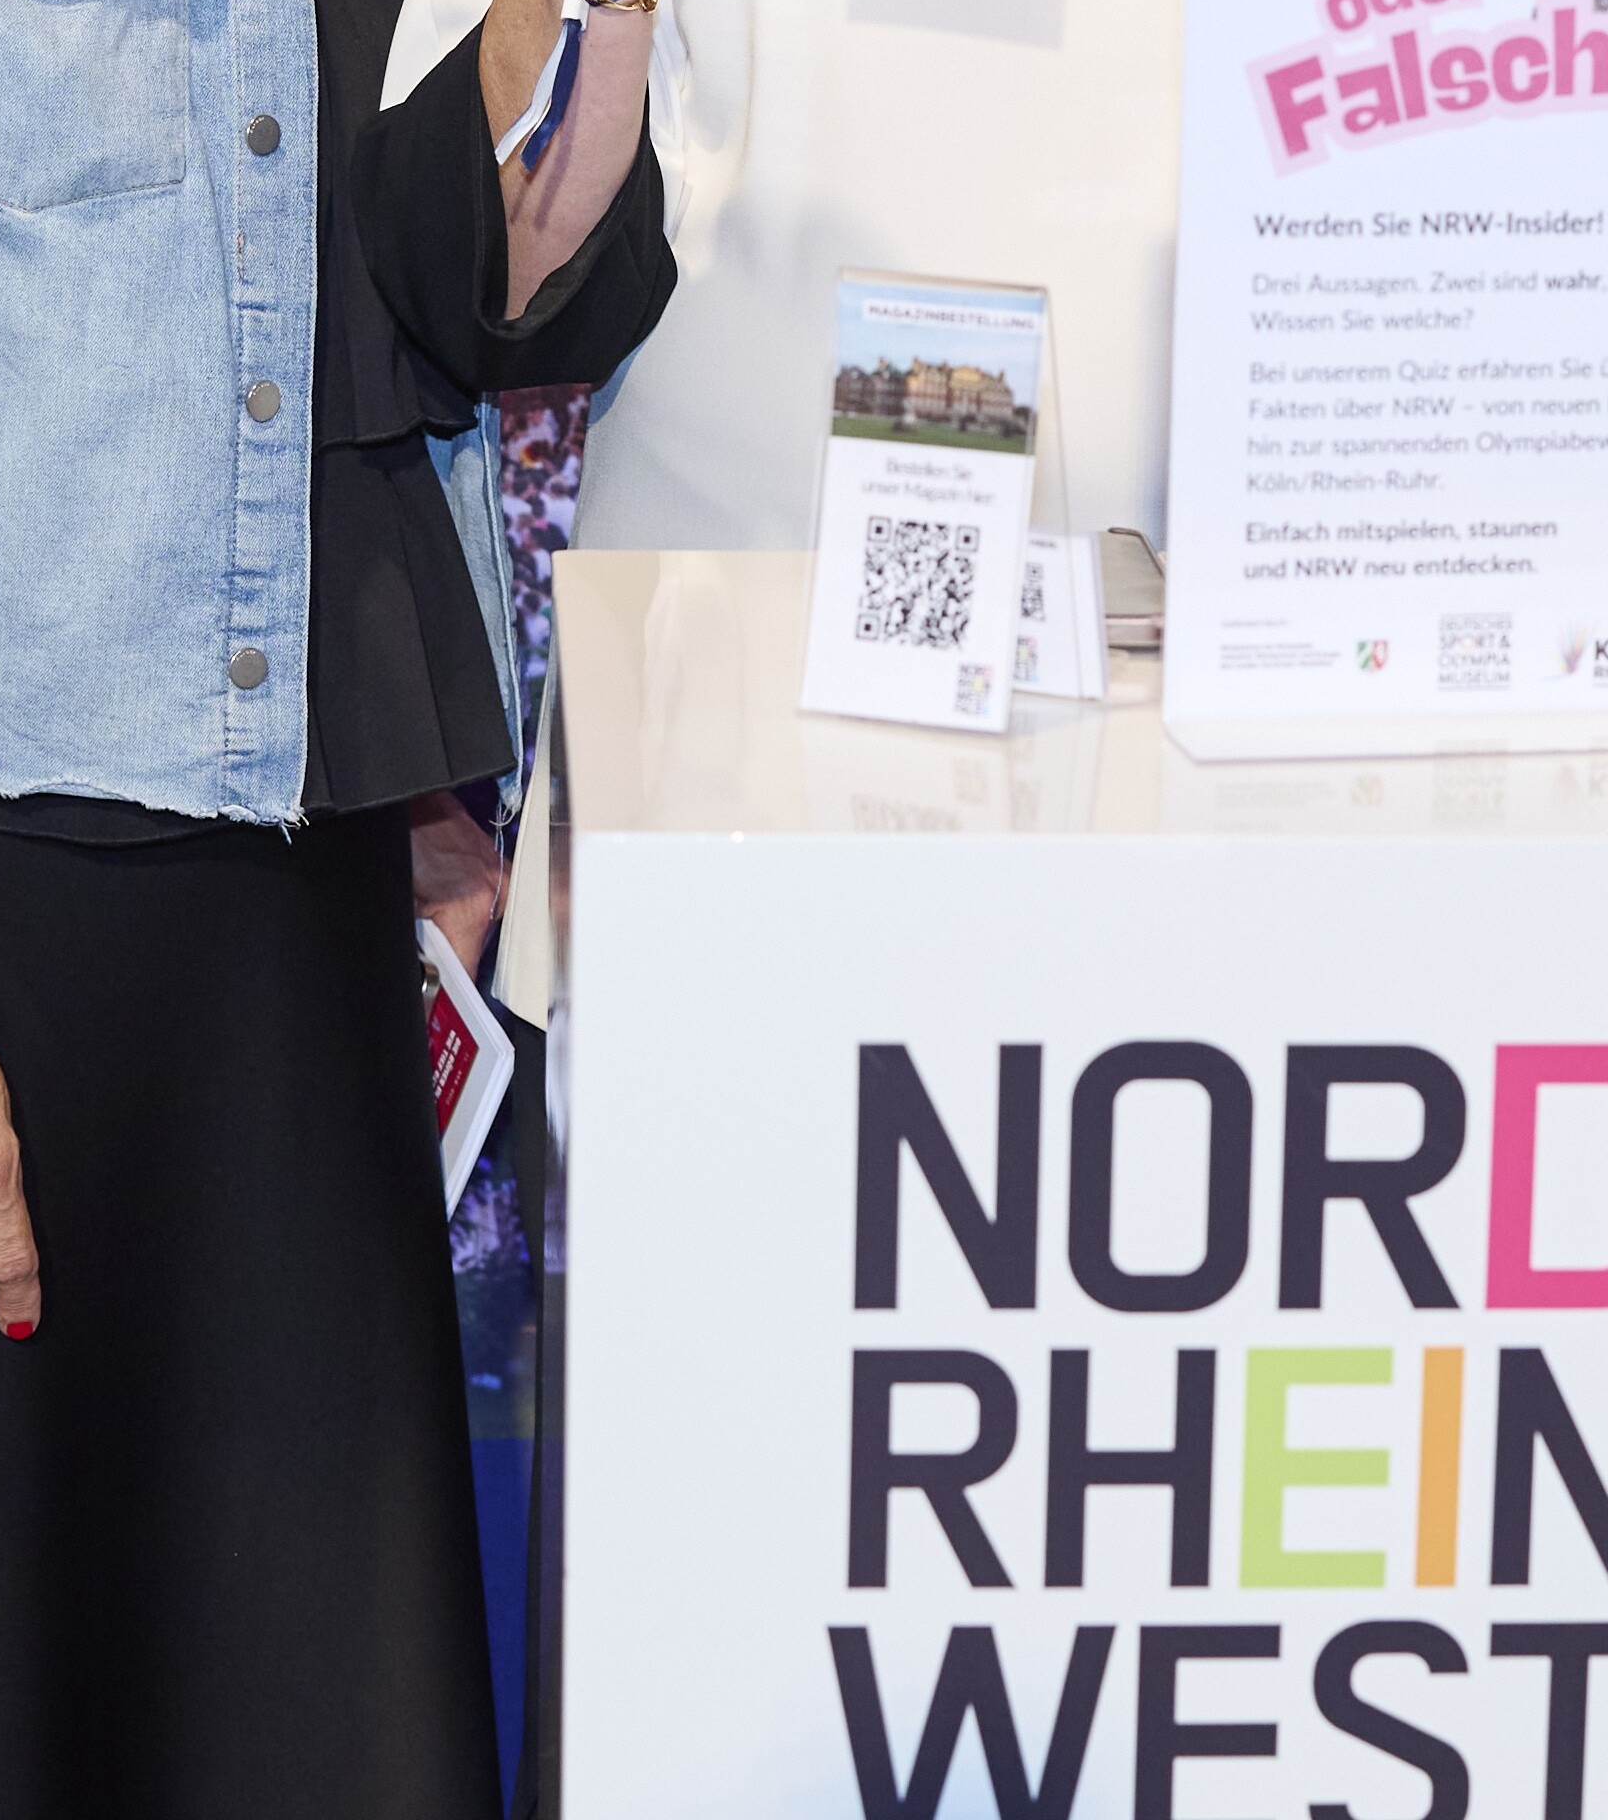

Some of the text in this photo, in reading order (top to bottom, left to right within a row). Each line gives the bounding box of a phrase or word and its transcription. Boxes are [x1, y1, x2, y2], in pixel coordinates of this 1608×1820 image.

[1254, 211, 1603, 237] Werden Sie NRW-Insider!
[1252, 273, 1301, 296] Drei
[1307, 273, 1420, 298] Aussagen.
[1430, 271, 1485, 293] Zwei
[1491, 271, 1538, 292] sind
[1545, 270, 1606, 292] wahr,
[1250, 307, 1474, 332] Wissen Sie welche?
[1249, 362, 1286, 384] Bei
[1292, 365, 1391, 383] unserem
[1397, 359, 1451, 385] Quiz
[1457, 359, 1553, 381] erfahren
[1560, 357, 1594, 379] Sie
[1249, 398, 1327, 420] Fakten
[1333, 398, 1385, 419] über
[1393, 396, 1455, 416] NRW
[1481, 400, 1525, 416] von
[1531, 399, 1601, 416] neuen
[1246, 435, 1283, 457] hin
[1289, 439, 1325, 457] zur
[1331, 434, 1469, 458] spannenden
[1246, 469, 1443, 494] Köln/Rhein-Ruhr.
[1245, 519, 1558, 544] Einfach mitspielen, staunen
[1243, 554, 1535, 580] und NRW neu entdecken.
